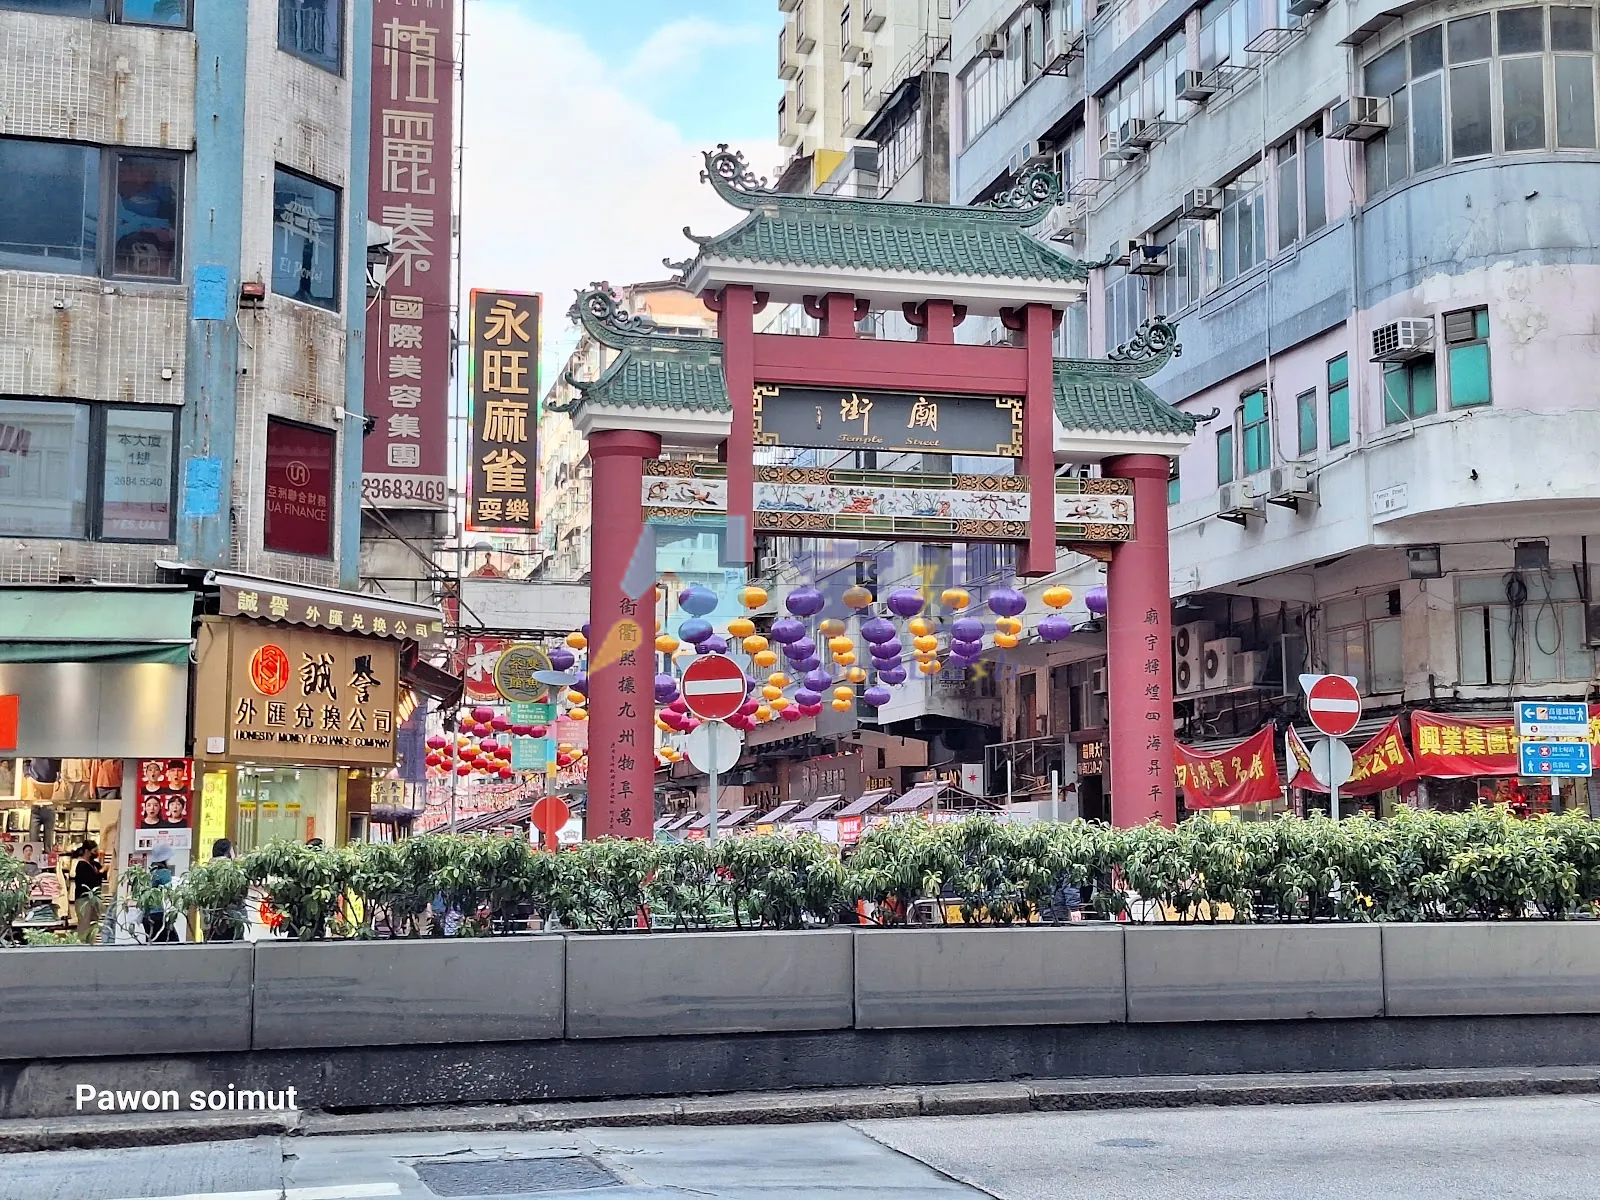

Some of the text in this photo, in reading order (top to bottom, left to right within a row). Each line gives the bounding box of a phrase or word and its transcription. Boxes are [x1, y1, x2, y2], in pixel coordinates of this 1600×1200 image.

[387, 294, 424, 469] 國際美容集團
[481, 299, 532, 493] 永旺麻雀
[839, 392, 939, 435] 廟街
[837, 433, 940, 446] Temple Street
[362, 478, 445, 501] 23683469
[266, 500, 327, 521] UA FINANCE
[478, 498, 530, 522] 耍樂
[237, 590, 289, 618] 誠譽
[298, 651, 381, 705] 誠譽
[234, 729, 391, 749] HONESTY MONEY EXCHANGE COMPANY
